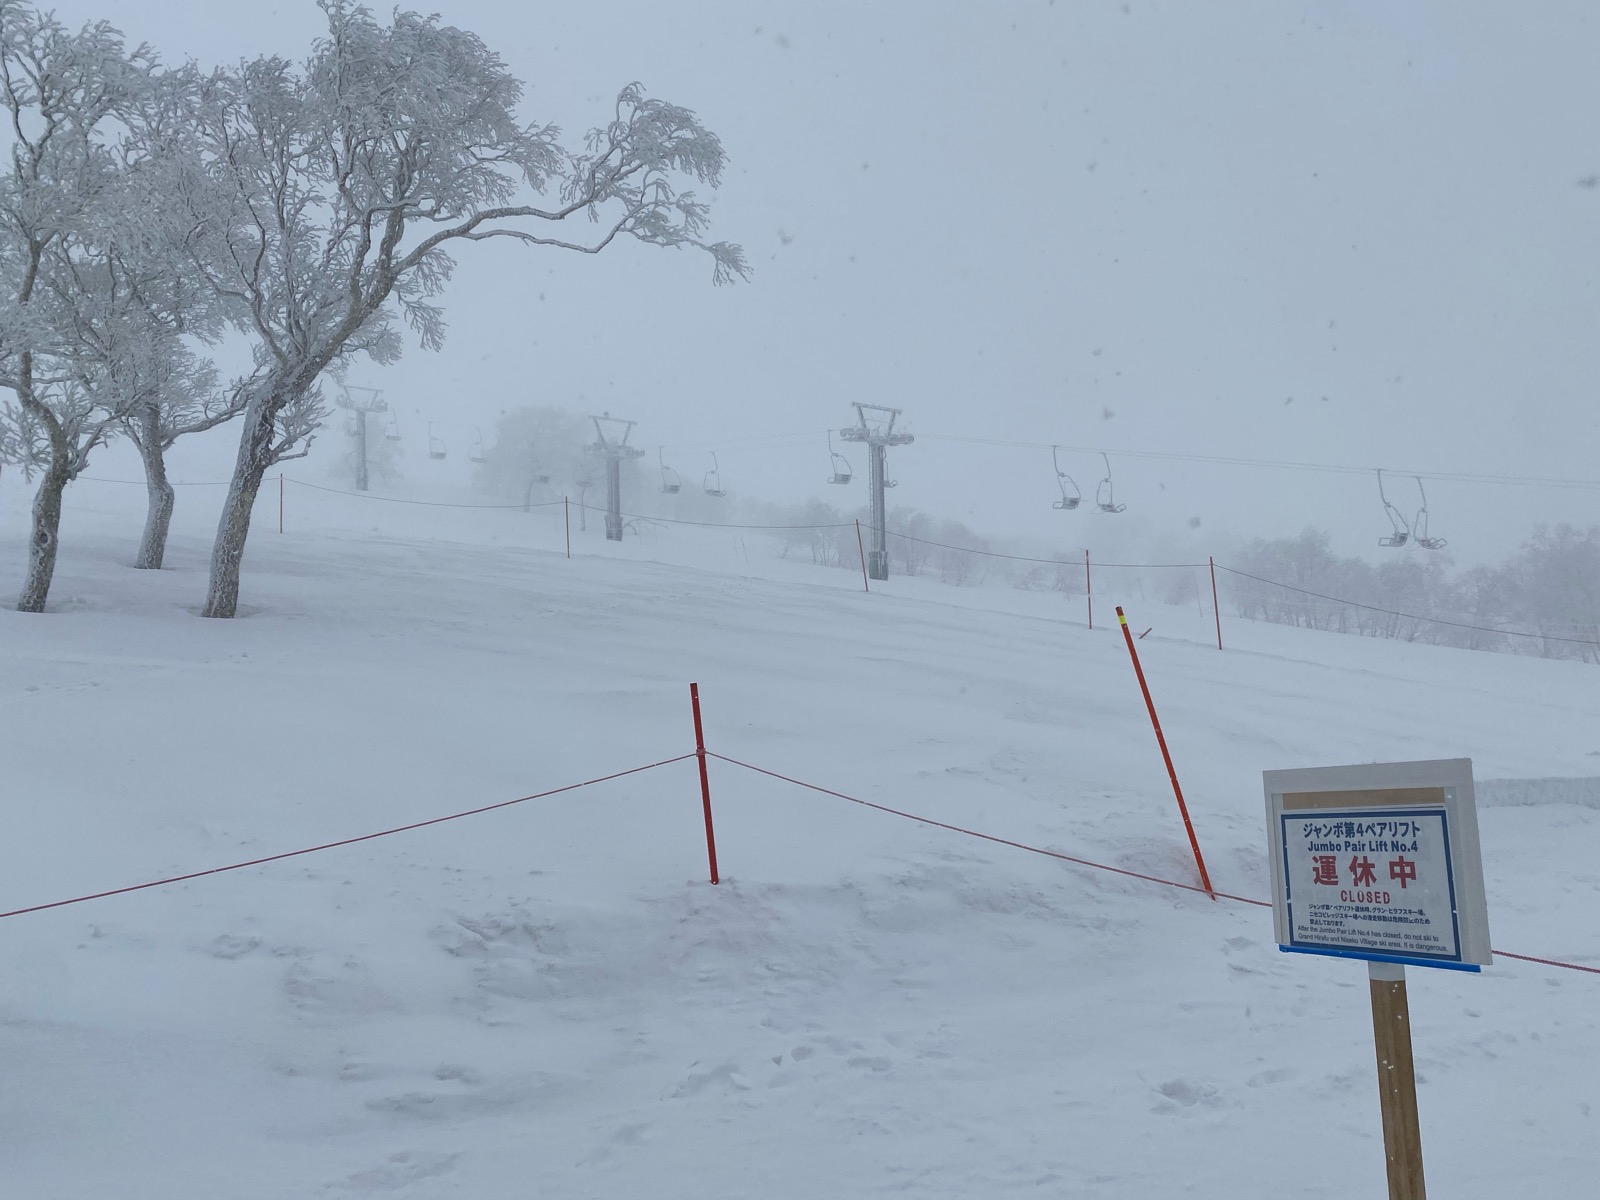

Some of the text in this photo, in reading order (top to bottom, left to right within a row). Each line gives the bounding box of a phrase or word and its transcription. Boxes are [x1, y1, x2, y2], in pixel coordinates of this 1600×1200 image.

[1303, 821, 1420, 838] ジャンボ第4ペアリフト
[1307, 841, 1418, 852] Jumbo Pair Lift No.4
[1312, 855, 1417, 889] 運休中
[1340, 890, 1391, 904] CLOSED
[1382, 931, 1402, 939] closed,
[1340, 936, 1358, 944] Niseko
[1360, 938, 1378, 946] Village
[1415, 943, 1448, 952] dangerous.
